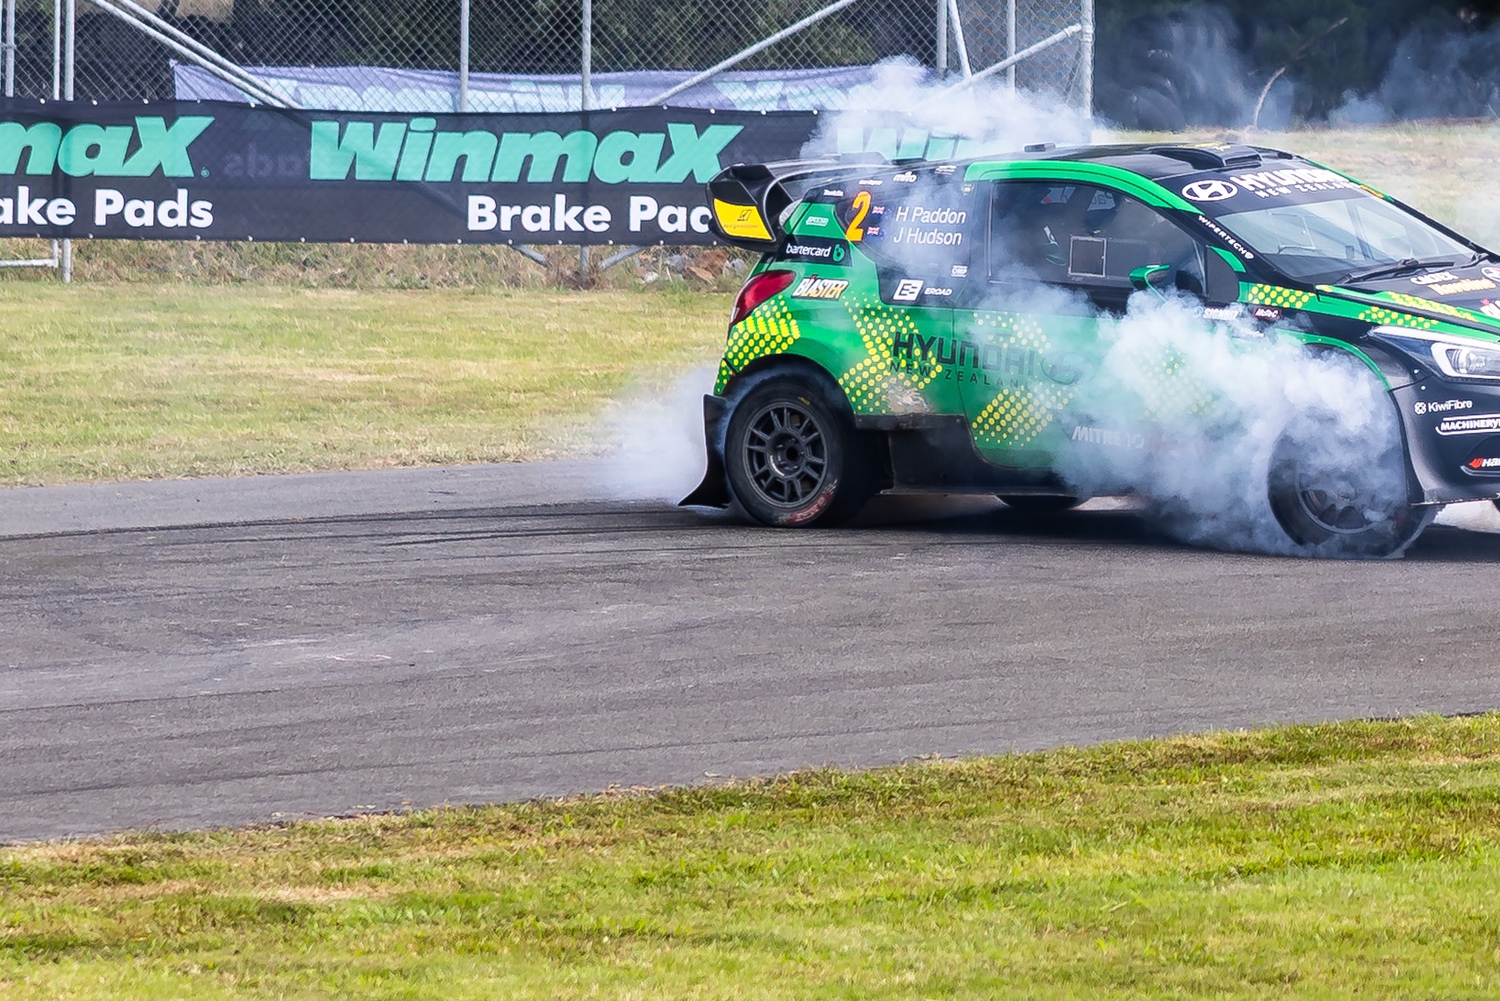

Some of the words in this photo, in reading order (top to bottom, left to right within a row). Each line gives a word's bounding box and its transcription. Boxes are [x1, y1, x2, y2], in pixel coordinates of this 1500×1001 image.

[310, 117, 745, 184] WinmaX
[94, 188, 214, 228] Pads
[467, 193, 612, 233] Brake
[846, 190, 872, 242] 2
[895, 206, 909, 222] H
[911, 207, 967, 224] Paddon
[893, 228, 903, 244] J
[907, 229, 962, 245] Hudson
[1198, 215, 1248, 255] WIPERTECH
[786, 243, 832, 257] bartercard
[791, 276, 849, 301] BLASTER
[924, 287, 953, 296] EROAD
[893, 332, 1037, 376] HYUNDAI
[890, 360, 932, 377] NEW
[1428, 400, 1473, 413] KiwiFibre
